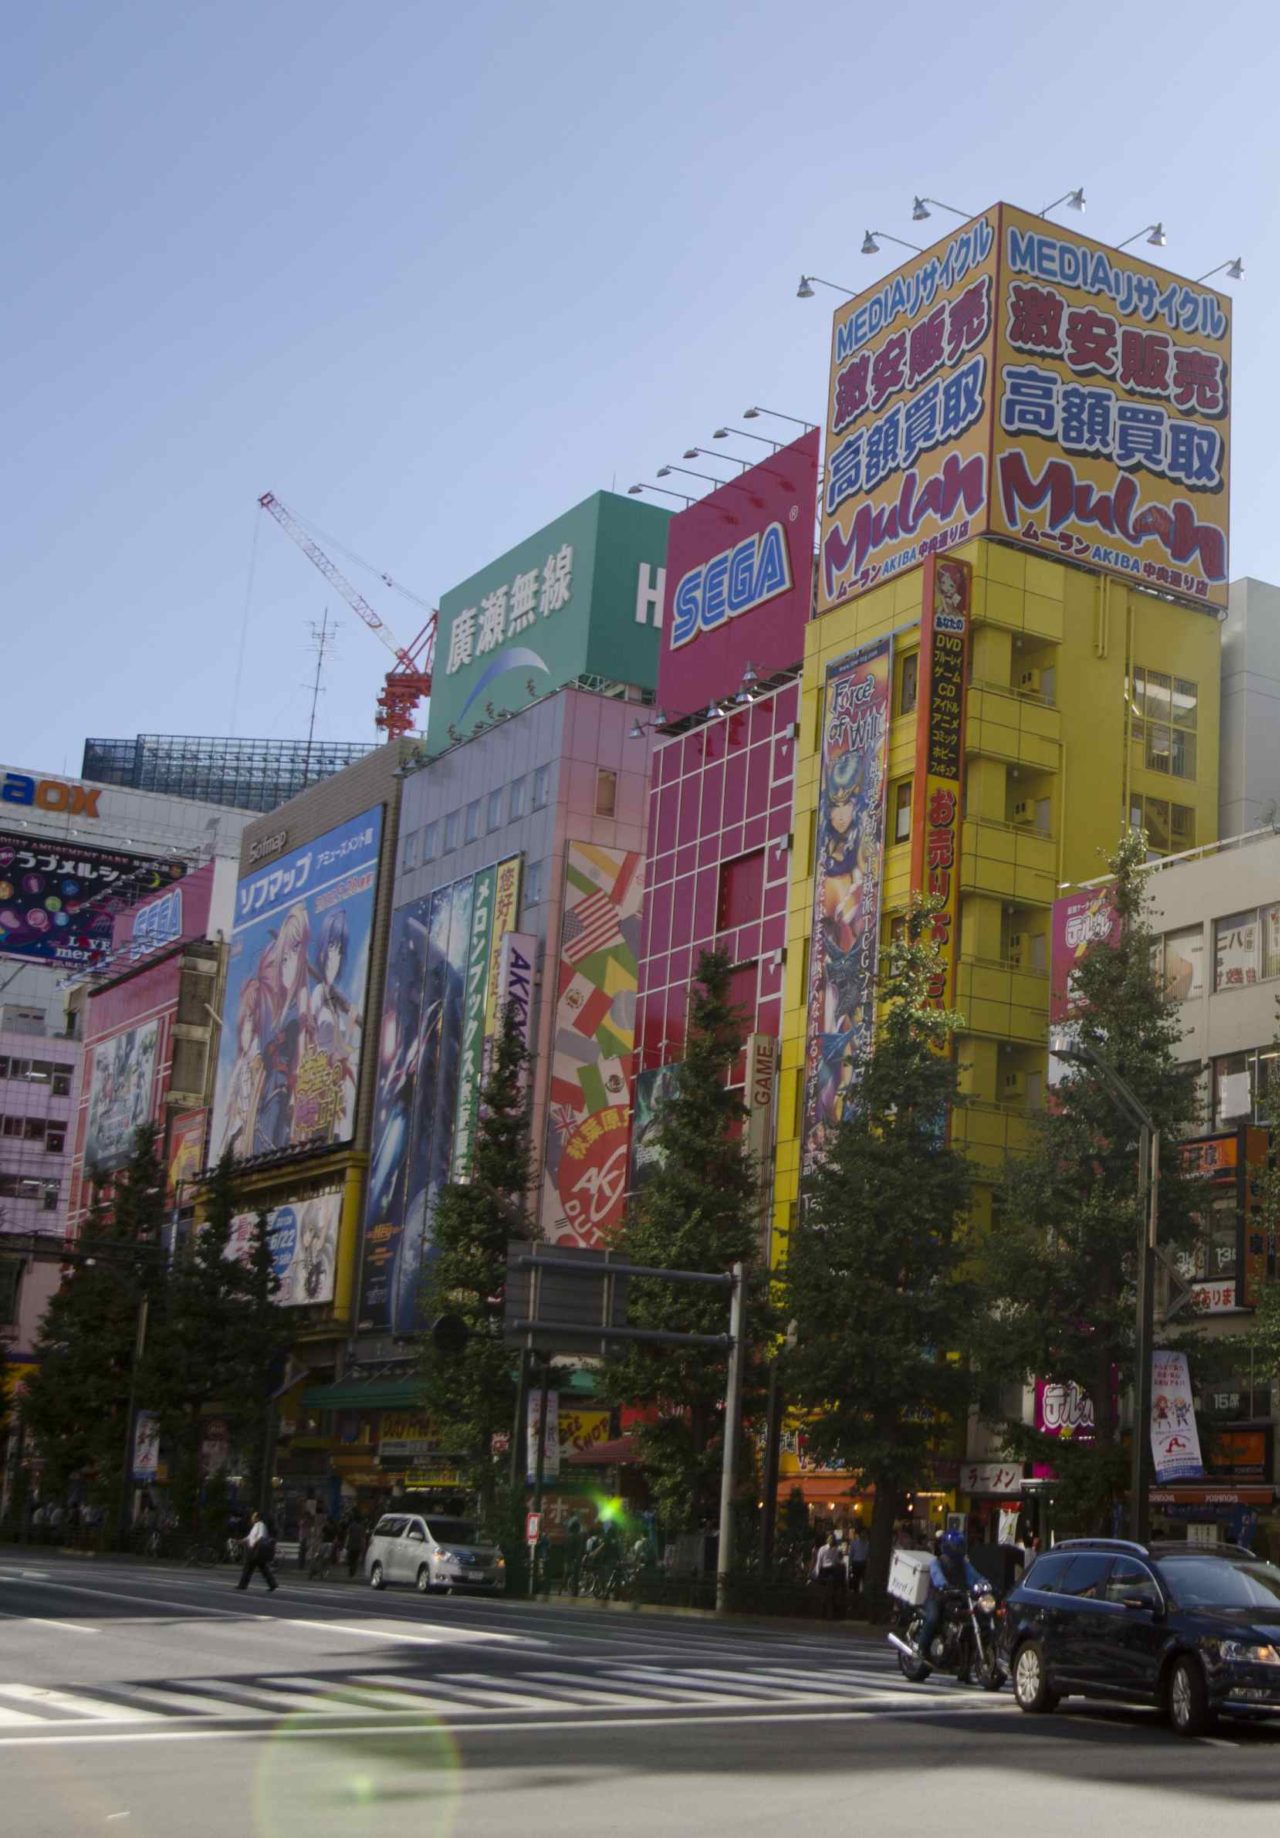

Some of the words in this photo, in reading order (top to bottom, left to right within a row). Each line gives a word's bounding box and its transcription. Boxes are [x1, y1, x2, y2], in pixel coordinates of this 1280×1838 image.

[1006, 229, 1227, 339] MEDIAリサイクル
[834, 276, 990, 430] 激安販売
[1006, 281, 1225, 414] 激安販売
[827, 356, 985, 514] 高額買取
[1002, 366, 1222, 487] 高額買取
[824, 450, 986, 603] Mulan
[999, 450, 1226, 582] Mulan
[1021, 521, 1091, 556] ムーラン
[1091, 547, 1141, 574] AKIBA
[1142, 561, 1210, 598] 中央通り店
[670, 521, 793, 651] SEGA
[835, 563, 882, 600] ムーラン
[882, 550, 917, 584] AKIBA
[936, 634, 962, 651] DVD
[932, 713, 959, 729] アニメ
[938, 683, 956, 698] CD
[241, 852, 312, 914] ソフマップ
[249, 831, 287, 864] Sofmap
[460, 876, 490, 1078] メロンブックス
[754, 1044, 776, 1107] GAME
[967, 1471, 1016, 1488] ラーメン
